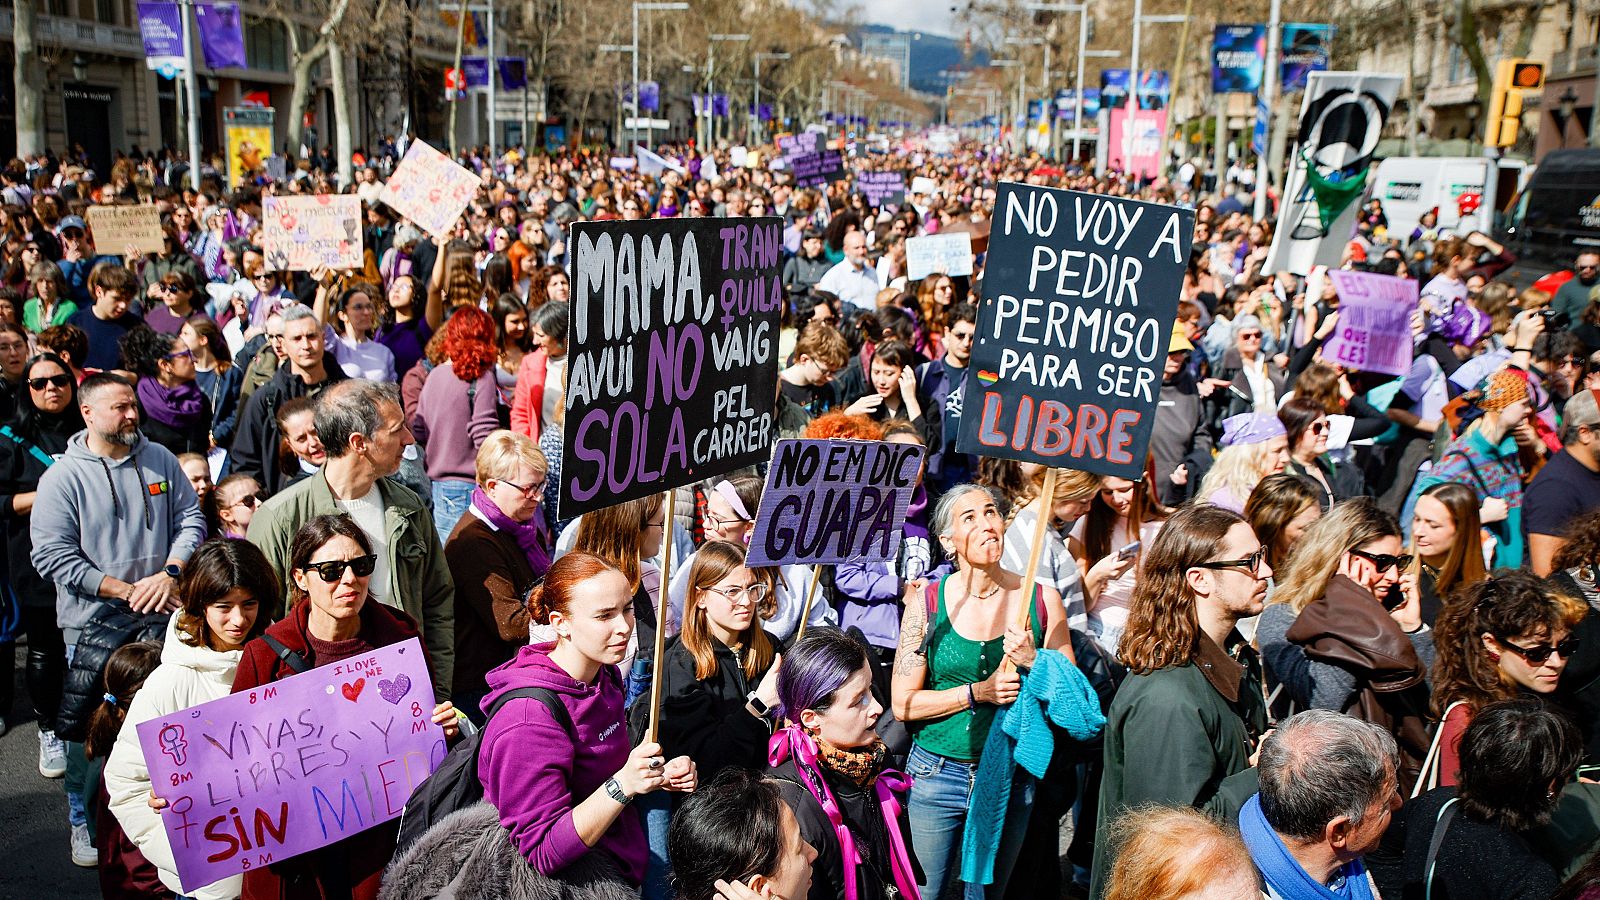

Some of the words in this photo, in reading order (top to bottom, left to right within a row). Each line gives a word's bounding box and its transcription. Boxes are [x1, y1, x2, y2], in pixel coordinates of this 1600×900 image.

[1005, 191, 1058, 238] NO
[1075, 196, 1144, 250] VOY
[1148, 212, 1183, 264] A
[576, 230, 714, 345] MAMA,
[1028, 245, 1143, 307] PEDIR
[994, 295, 1160, 363] PERMISO
[645, 322, 705, 410] NO
[999, 348, 1083, 391] PARA
[1097, 363, 1156, 403] SER
[713, 384, 755, 424] PEL
[978, 391, 1141, 465] LIBRE
[693, 412, 772, 465] CARRER
[774, 441, 820, 489] NO
[823, 444, 868, 484] EM
[765, 486, 897, 561] GUAPA
[334, 665, 343, 677] I
[346, 657, 378, 673] LOVE
[365, 666, 383, 678] ME
[370, 716, 394, 754] Y
[170, 771, 193, 786] 8M
